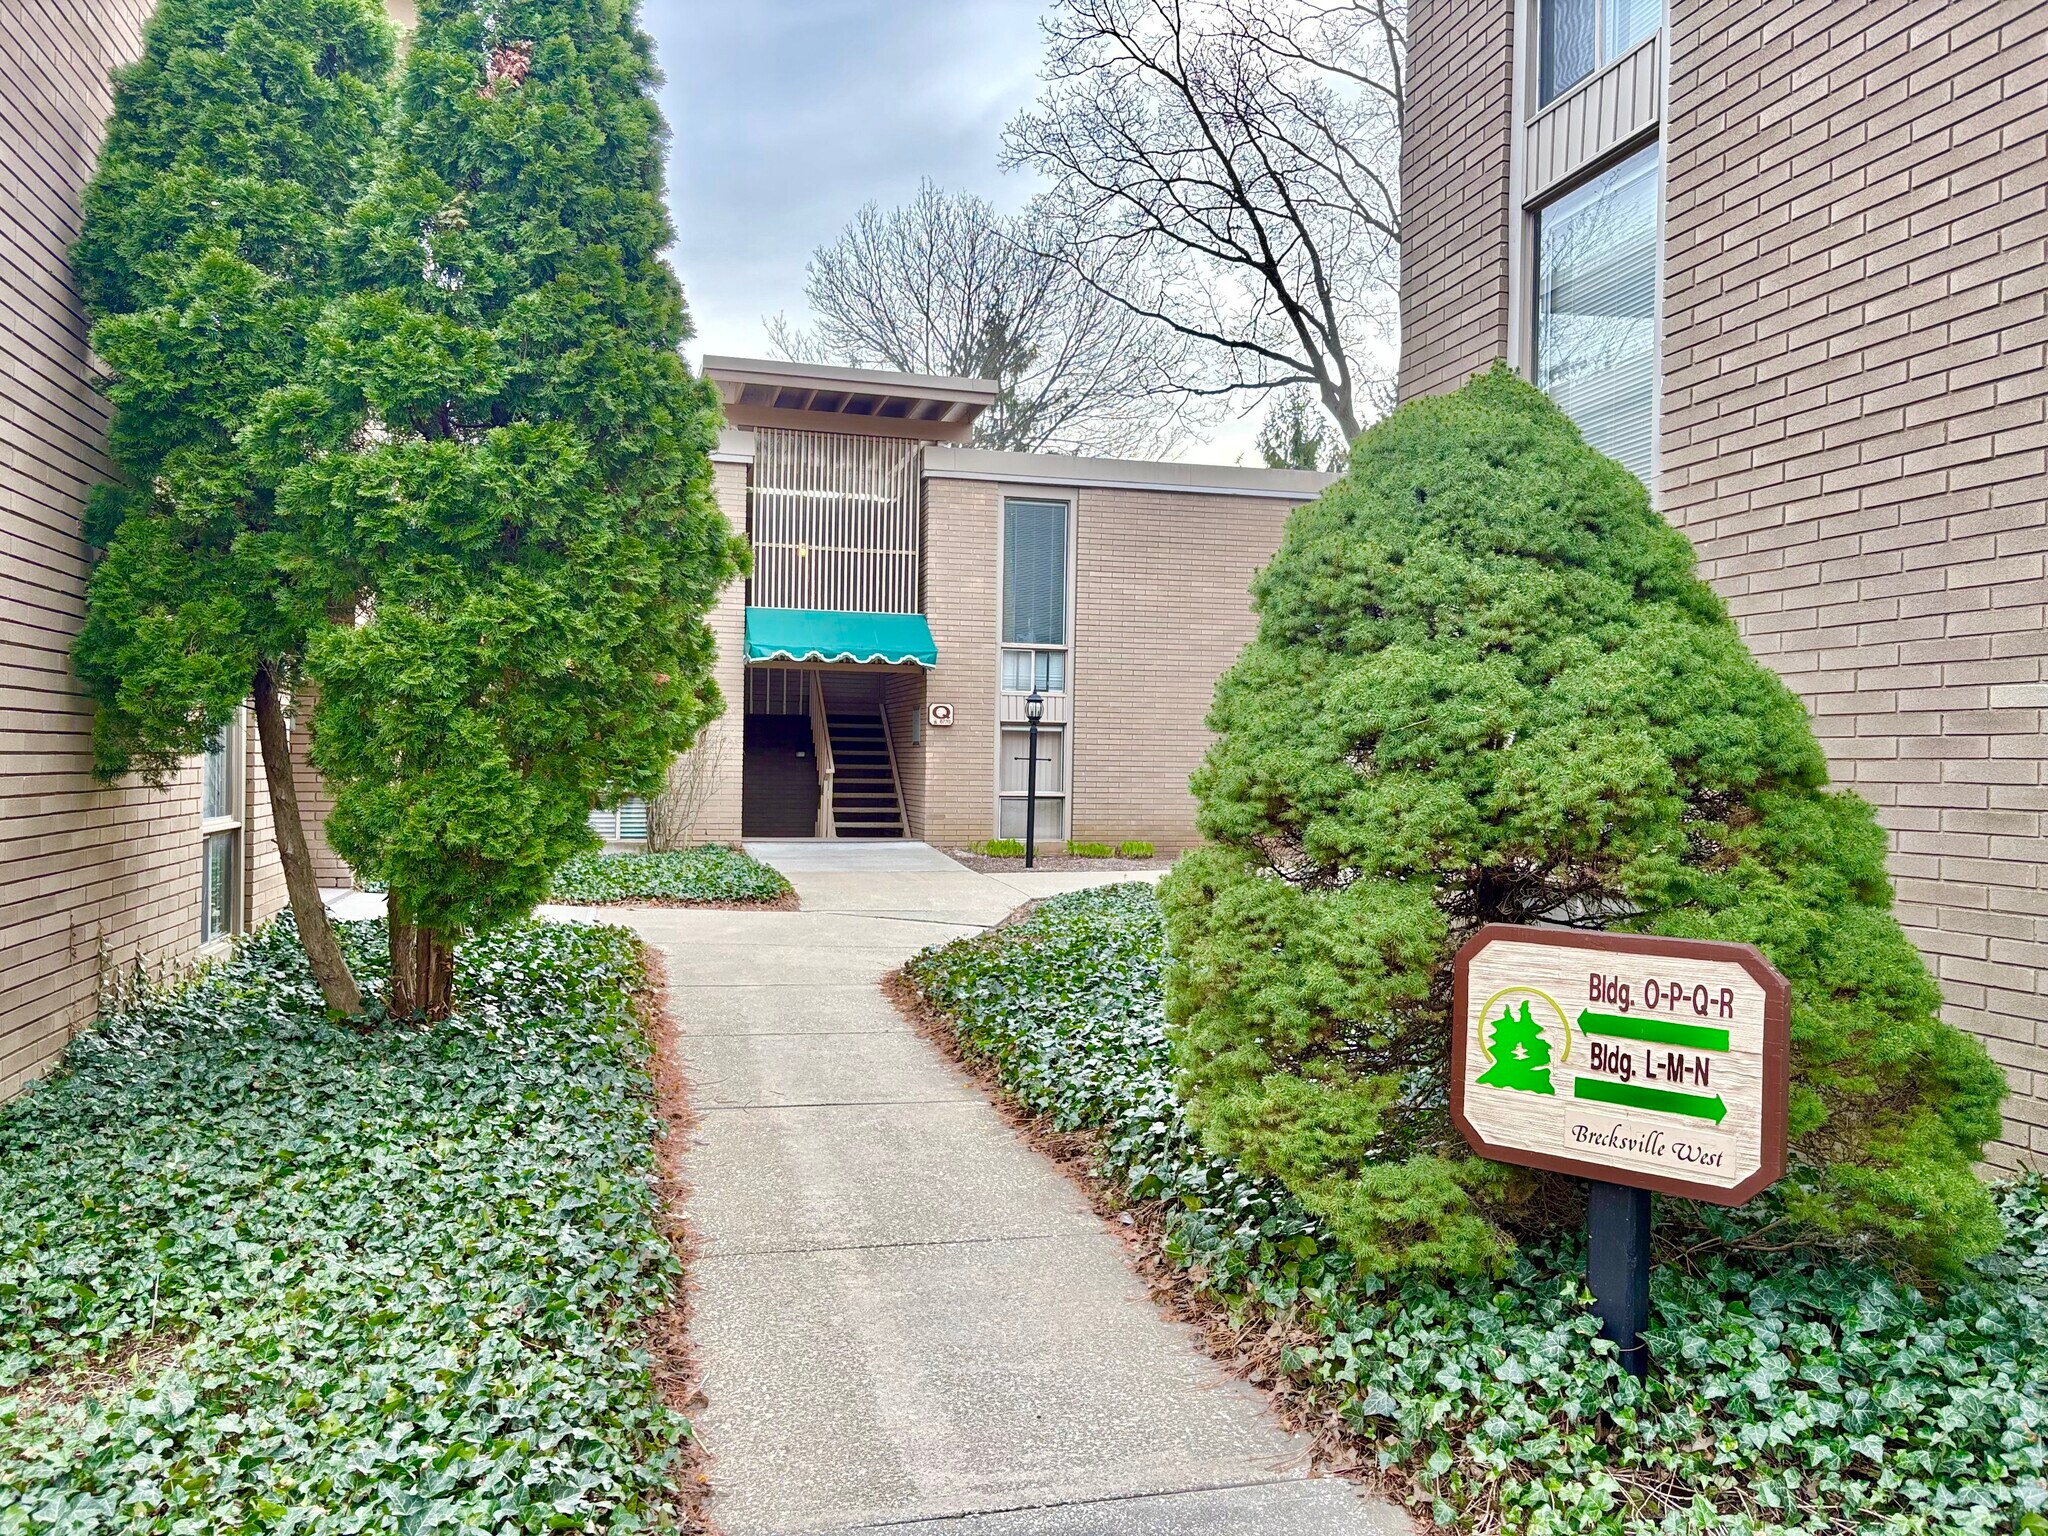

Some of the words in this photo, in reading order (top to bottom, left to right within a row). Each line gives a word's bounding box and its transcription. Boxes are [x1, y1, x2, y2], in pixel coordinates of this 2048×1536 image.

[932, 705, 951, 719] Q
[1589, 973, 1635, 1012] Bldg.
[1644, 978, 1734, 1018] O-P-Q-R
[1590, 1042, 1636, 1082] Bldg.
[1646, 1049, 1710, 1086] L-M-N
[1571, 1124, 1666, 1156] Brecksville
[1671, 1142, 1723, 1167] West
